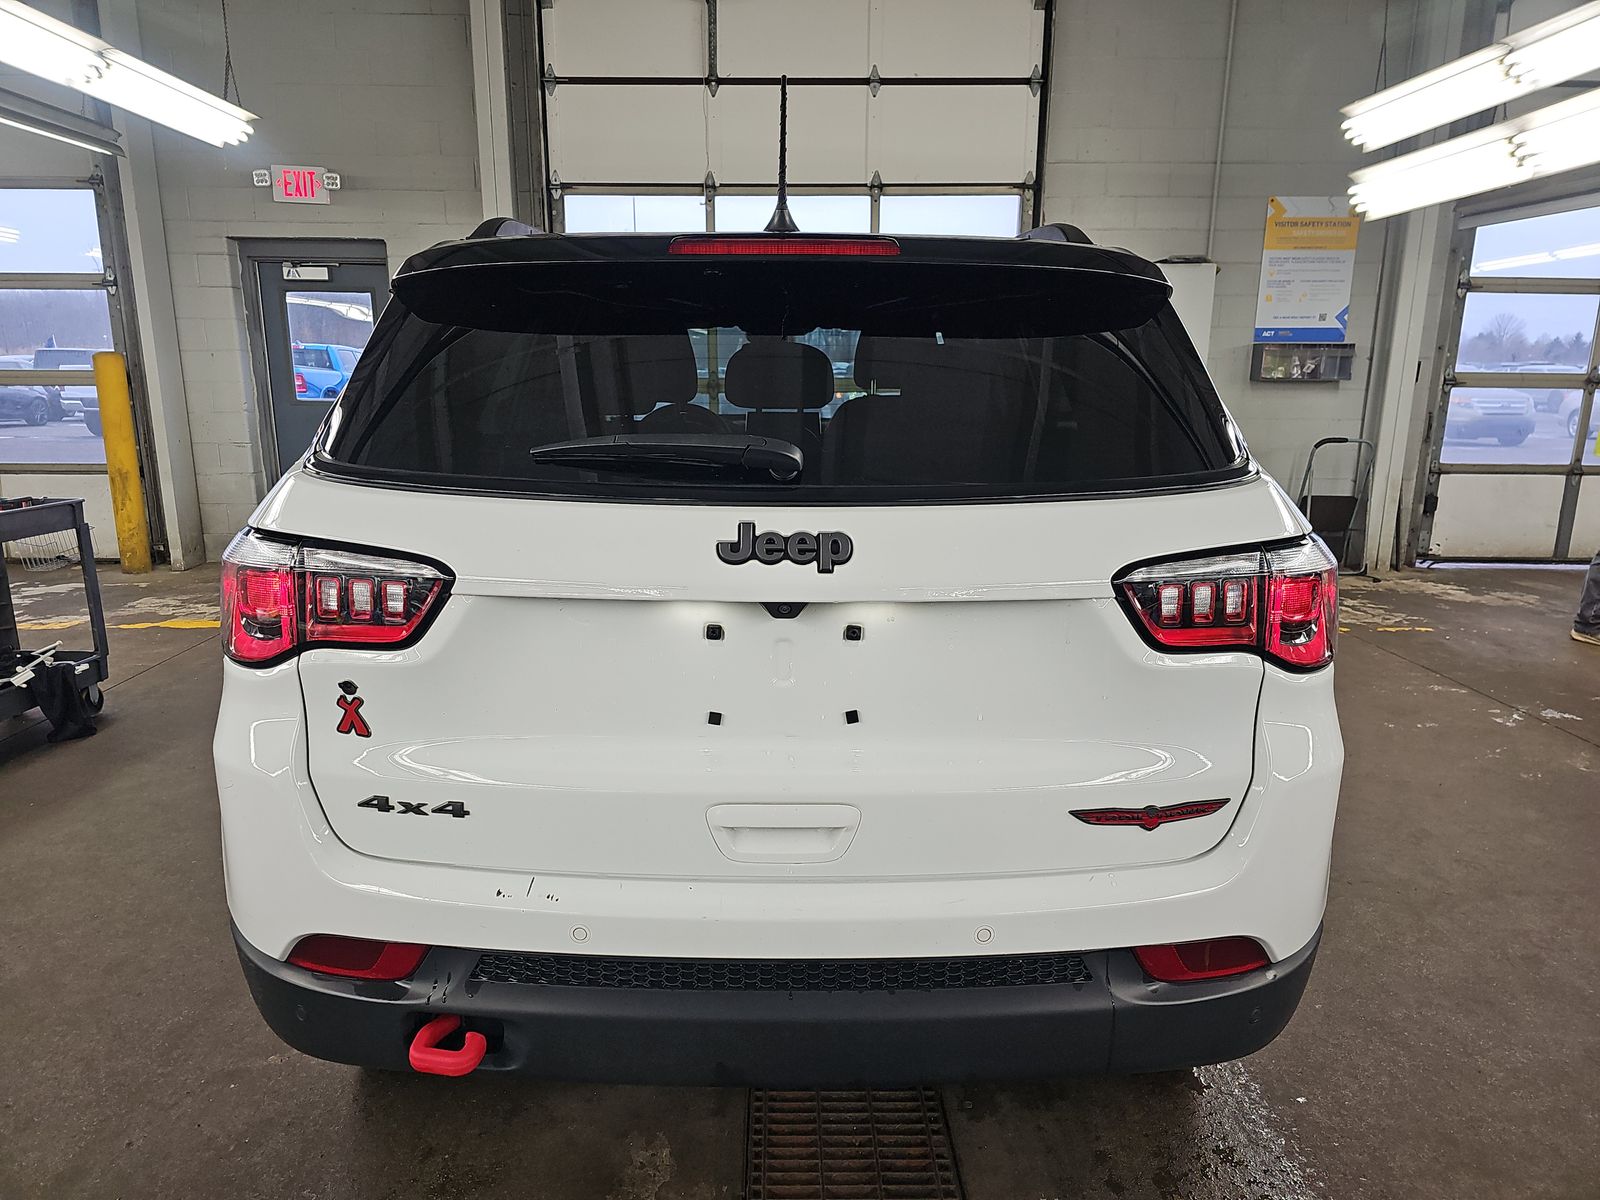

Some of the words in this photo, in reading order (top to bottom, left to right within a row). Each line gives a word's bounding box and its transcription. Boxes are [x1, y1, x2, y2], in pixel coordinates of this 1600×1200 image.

[282, 169, 316, 198] EXIT
[716, 521, 854, 574] Jeep
[357, 795, 471, 818] 4x4
